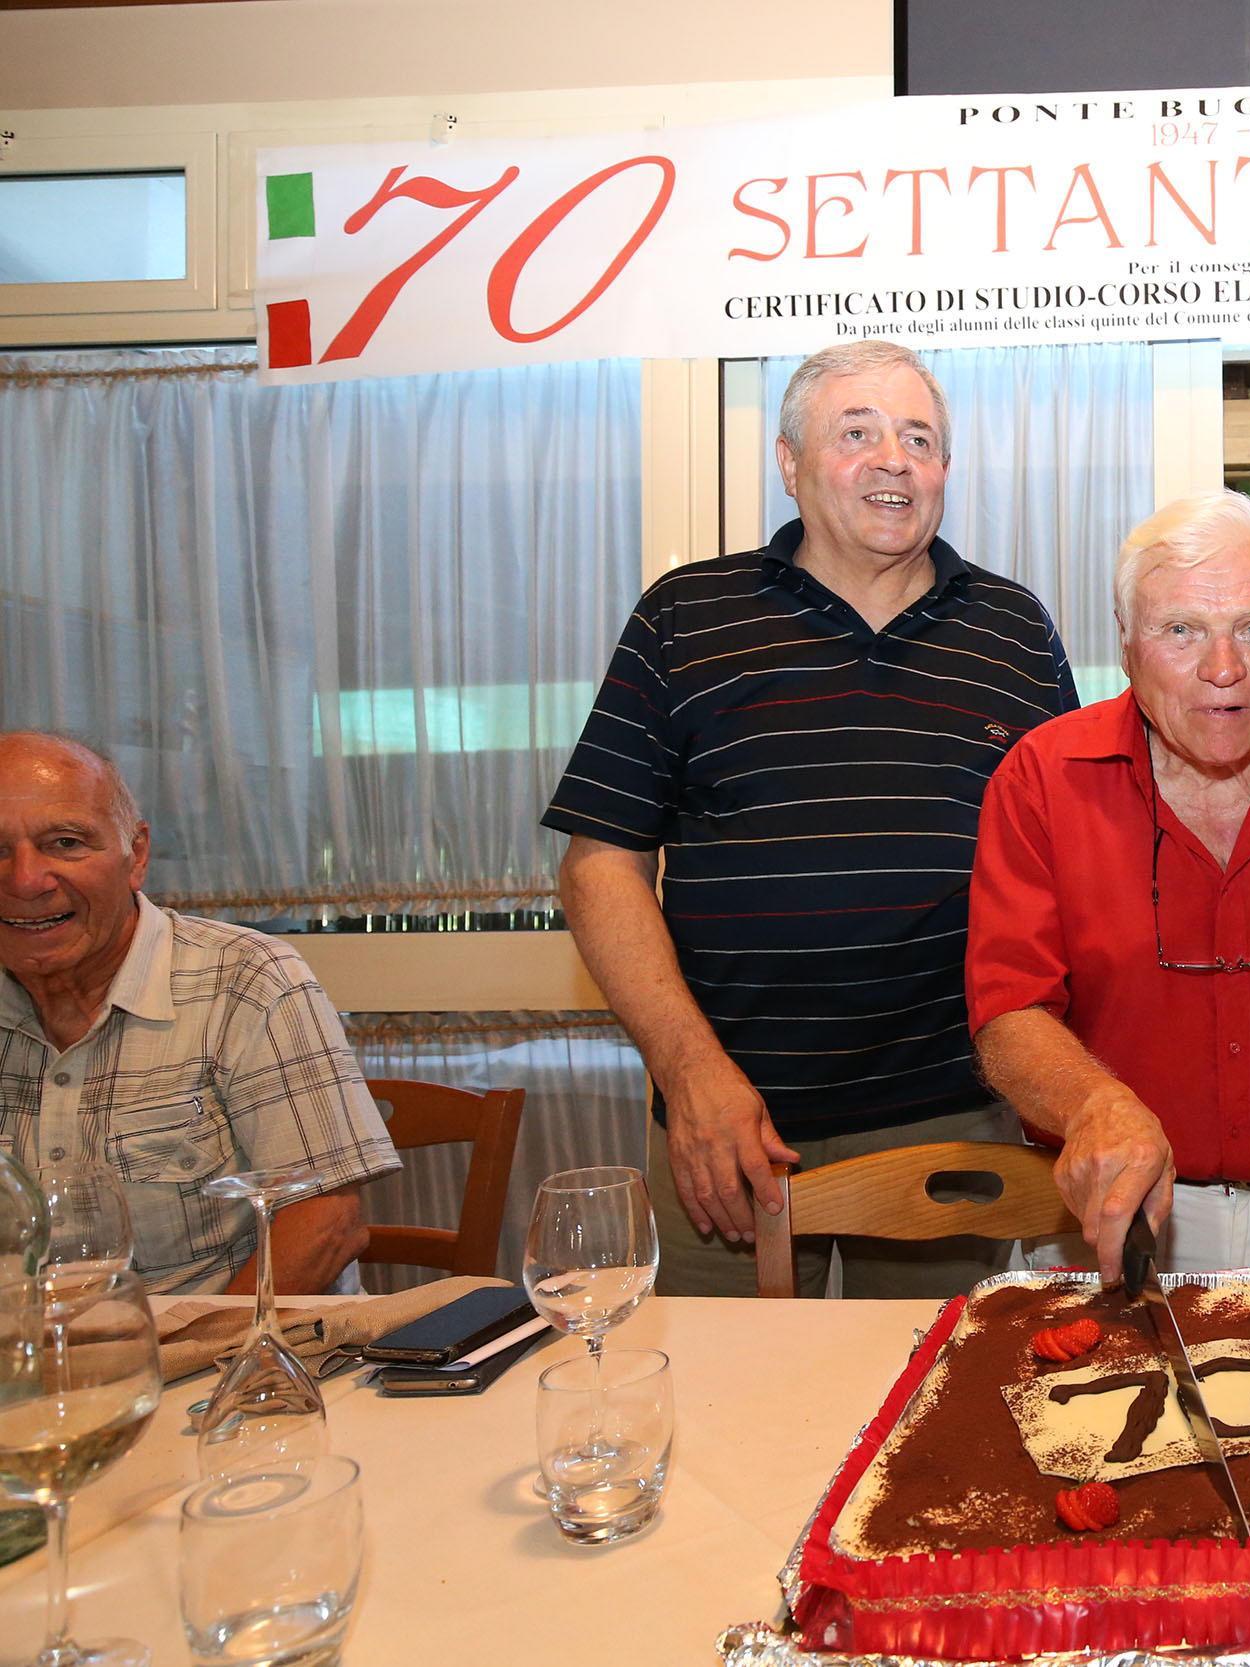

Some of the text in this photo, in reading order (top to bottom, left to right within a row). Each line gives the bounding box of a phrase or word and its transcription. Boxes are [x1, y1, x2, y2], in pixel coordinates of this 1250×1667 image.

[959, 101, 1135, 126] PONTE
[1150, 121, 1219, 146] 1947
[317, 154, 677, 365] 70
[1128, 261, 1160, 276] Per
[1169, 259, 1182, 274] il
[724, 290, 927, 320] CERTIFICATO
[936, 288, 965, 313] DI
[974, 280, 1202, 311] STUDIO-CORSO
[835, 321, 858, 336] Da
[862, 321, 903, 338] parte
[907, 317, 945, 336] degli
[948, 316, 998, 333] alunni
[1003, 315, 1041, 331] delle
[1044, 313, 1086, 330] classi
[1091, 312, 1140, 331] quinte
[1145, 311, 1169, 326] del
[1173, 309, 1241, 326] Comune
